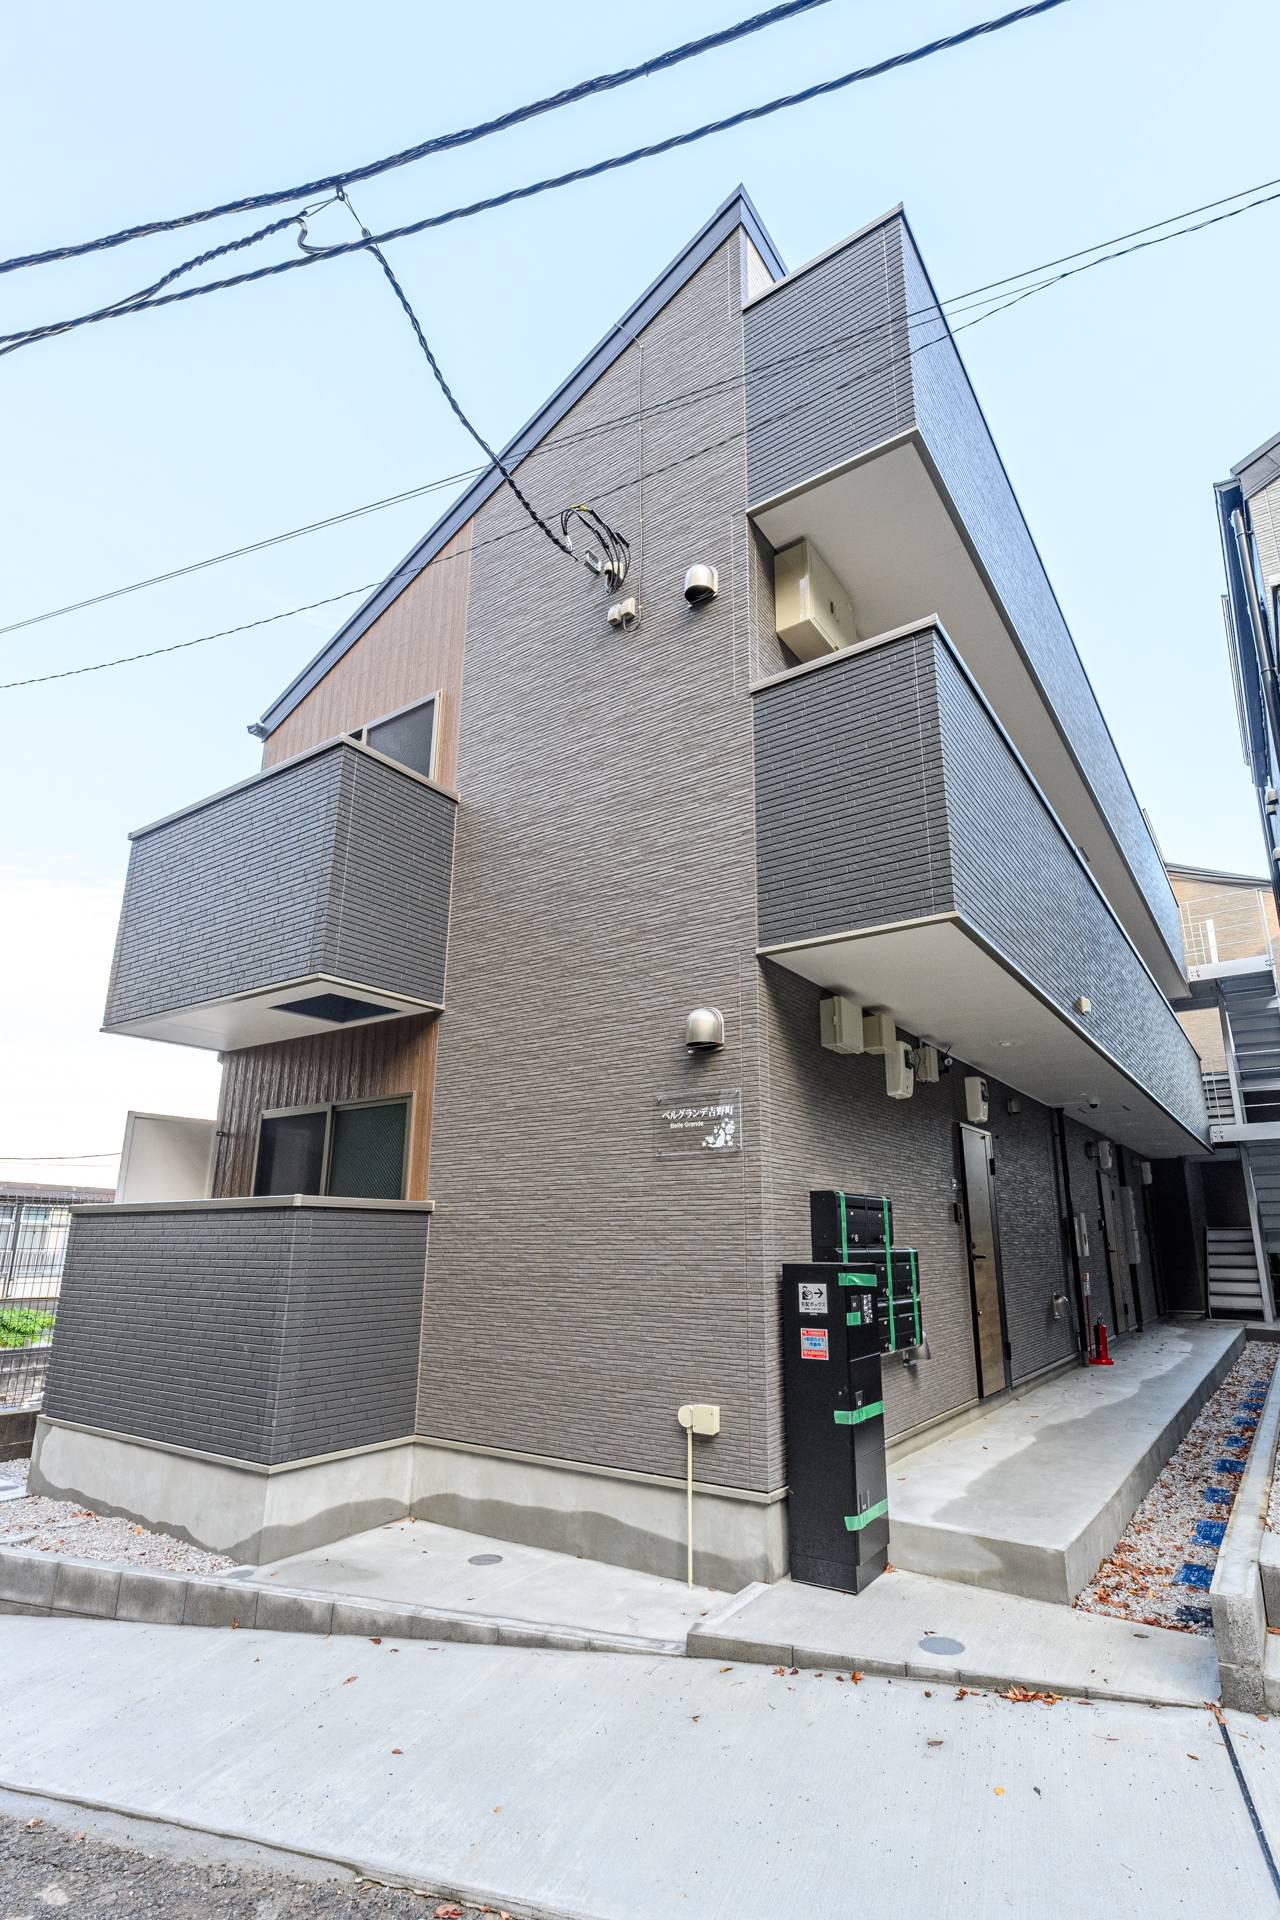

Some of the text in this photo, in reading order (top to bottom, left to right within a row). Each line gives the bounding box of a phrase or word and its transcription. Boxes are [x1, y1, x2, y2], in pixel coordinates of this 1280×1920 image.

[662, 1105, 733, 1119] ベルグランデ吉野町
